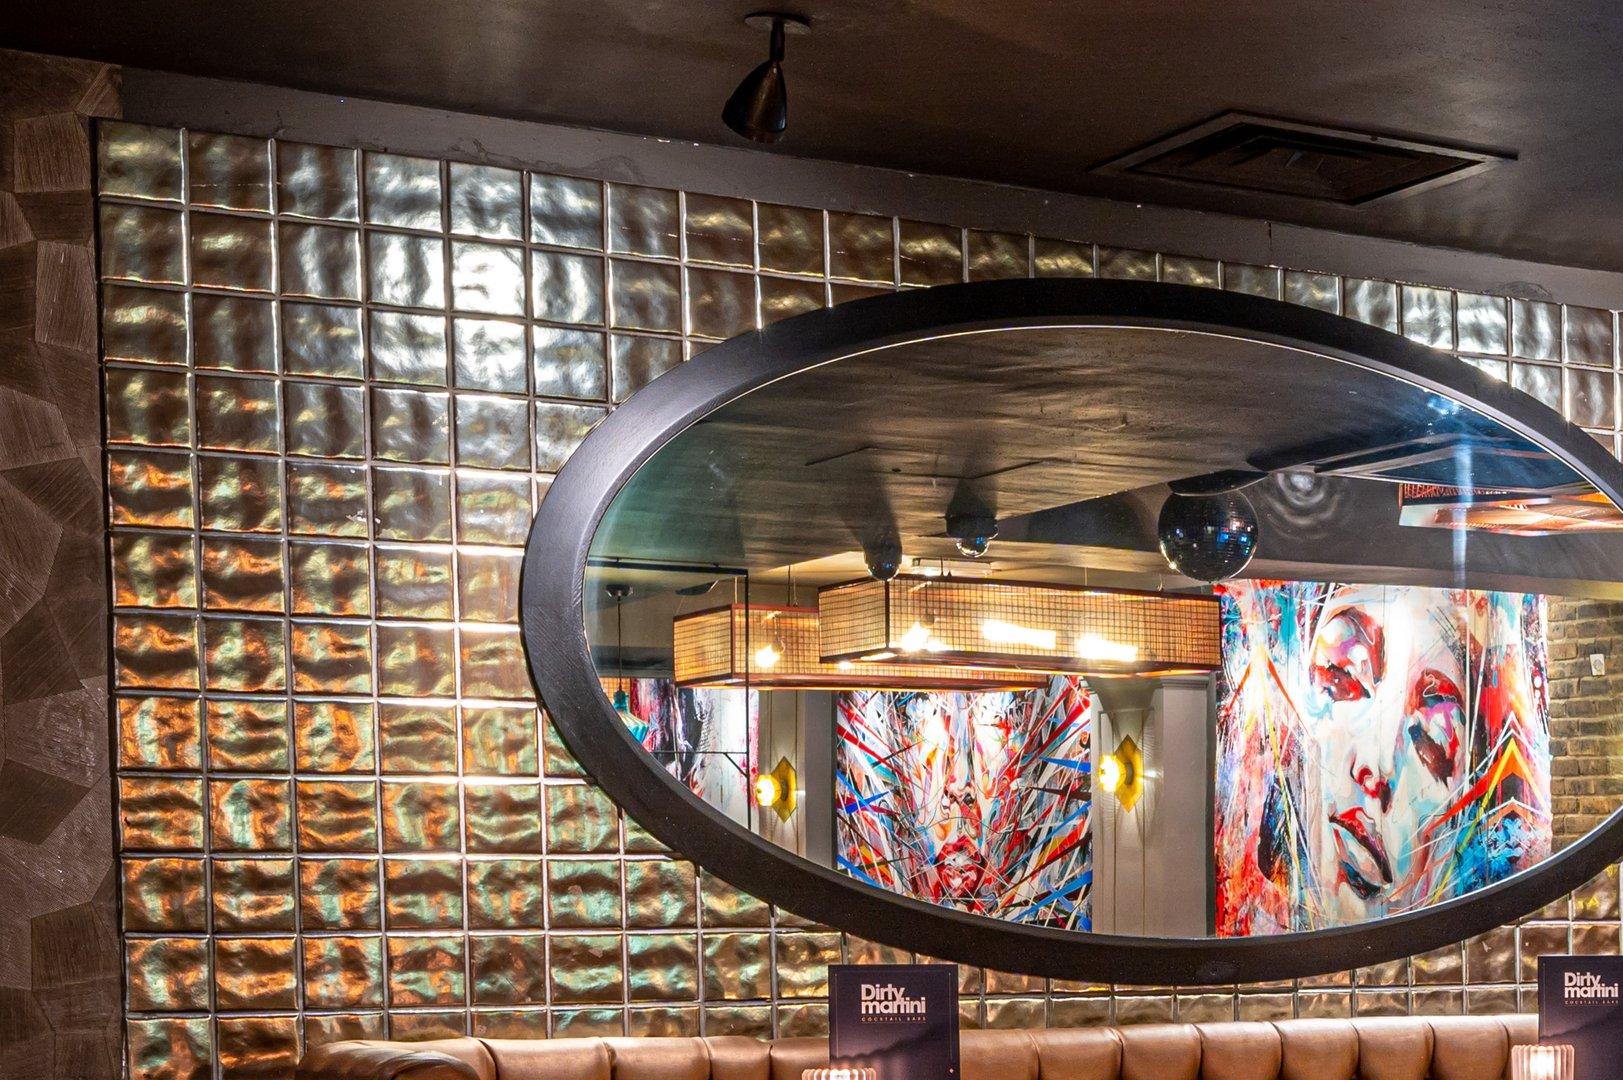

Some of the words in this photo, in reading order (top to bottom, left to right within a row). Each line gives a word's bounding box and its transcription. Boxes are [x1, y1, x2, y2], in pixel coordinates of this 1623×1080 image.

[1564, 972, 1601, 988] Dirty
[861, 984, 905, 1002] Dirty
[1564, 983, 1619, 998] martini
[861, 997, 926, 1014] martini
